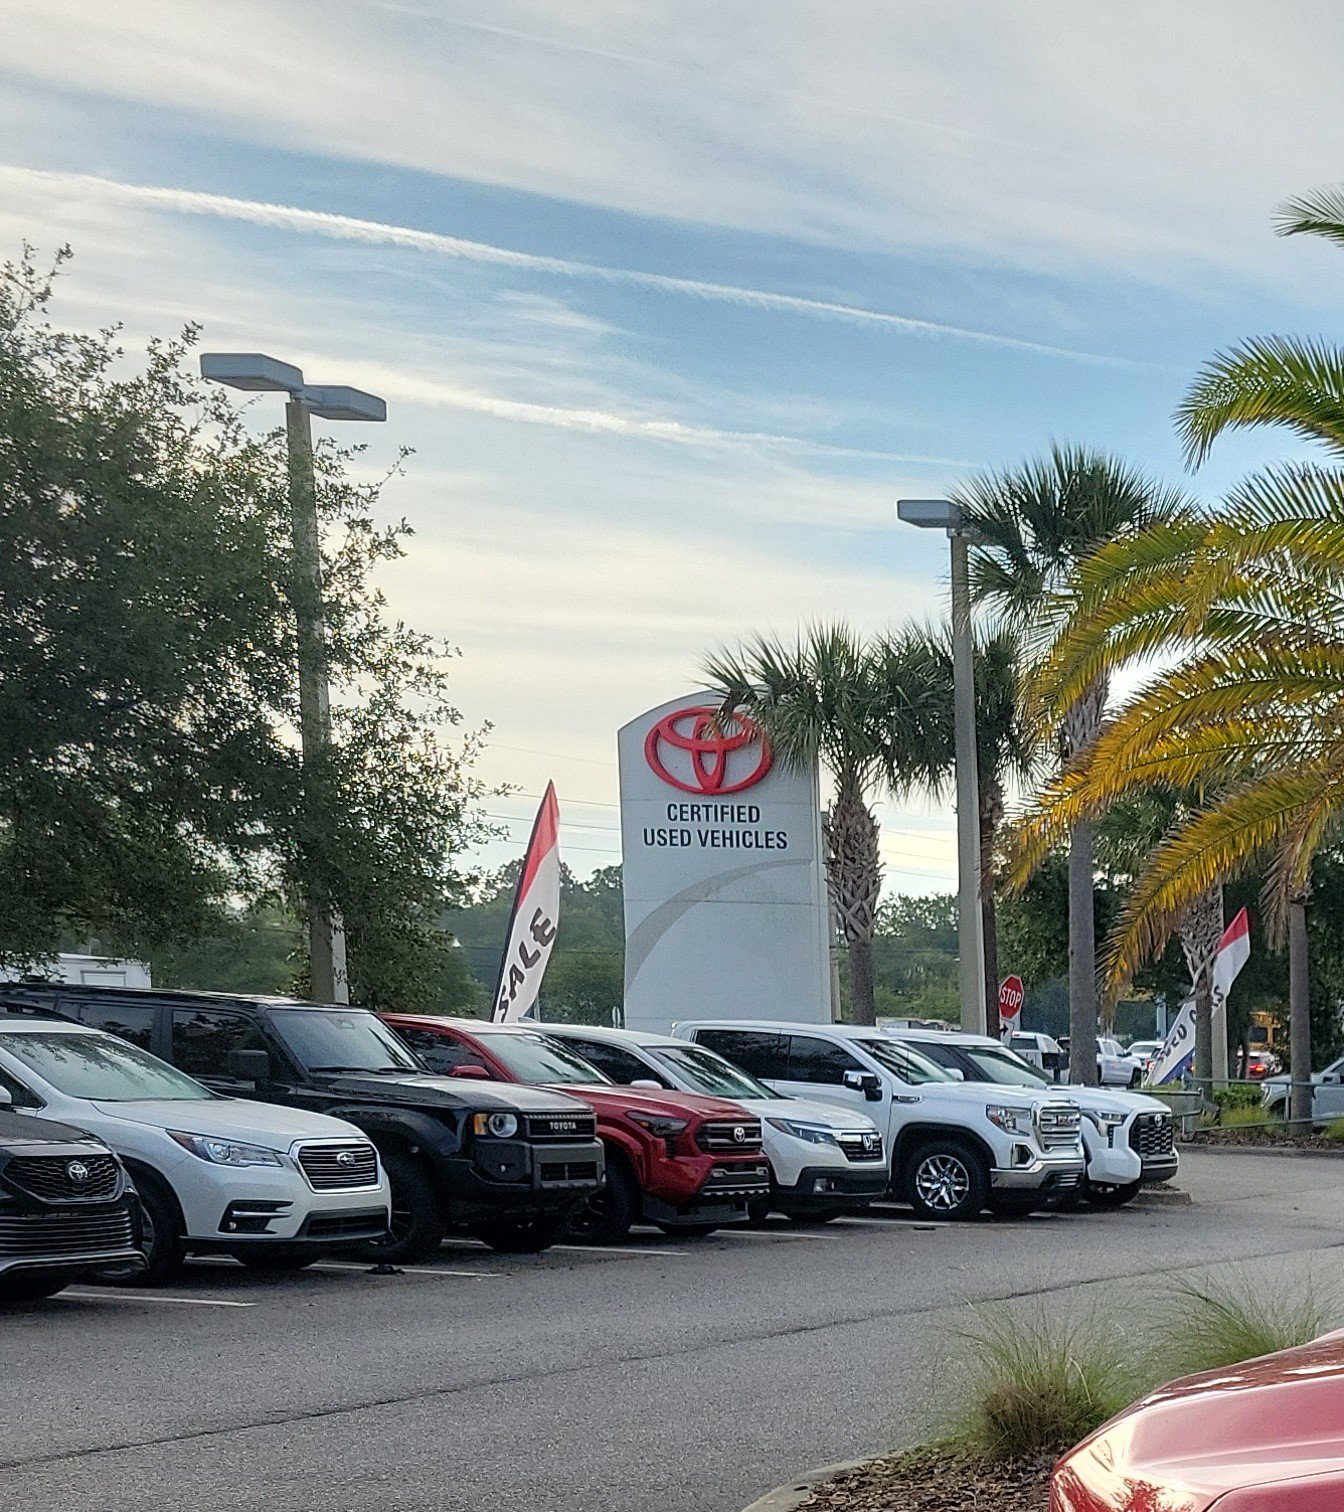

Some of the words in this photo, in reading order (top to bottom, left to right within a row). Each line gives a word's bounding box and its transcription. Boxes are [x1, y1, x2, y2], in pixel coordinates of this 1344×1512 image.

[667, 803, 761, 824] CERTIFIED
[643, 828, 692, 847] USED
[697, 829, 788, 850] VEHICLES
[498, 907, 556, 1023] SALE
[1000, 986, 1022, 1008] STOP
[549, 1121, 577, 1130] TOYOTA
